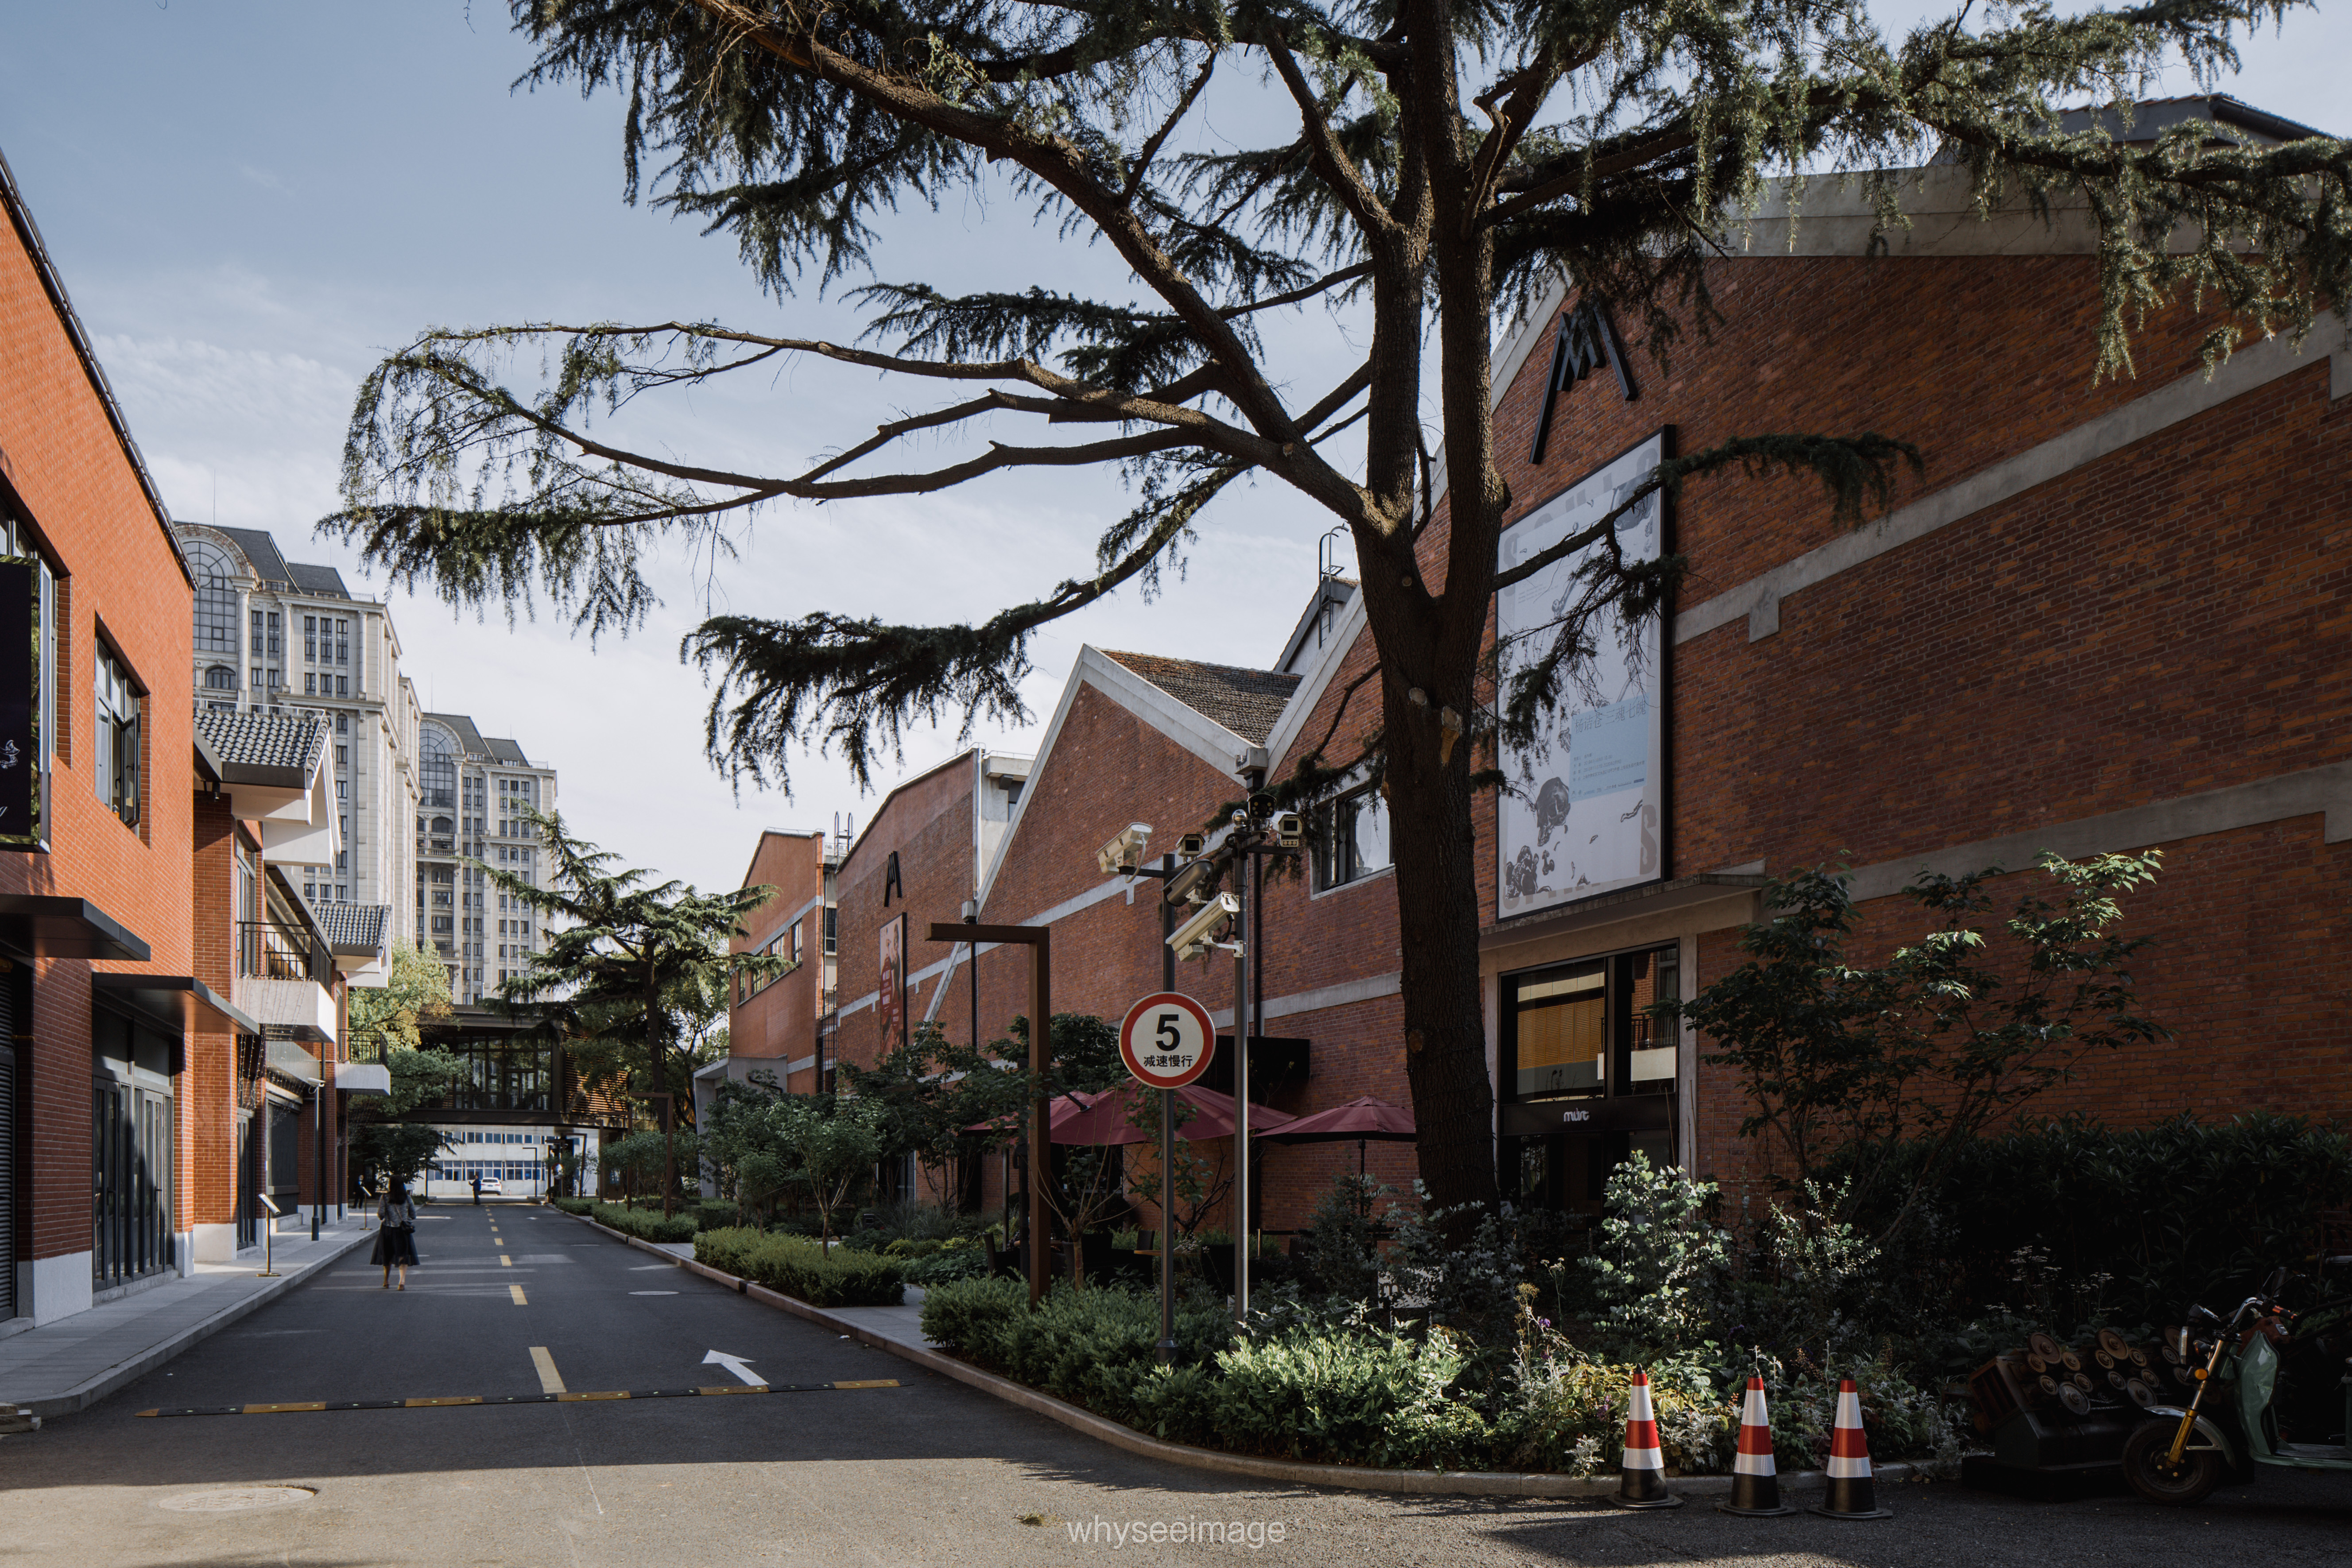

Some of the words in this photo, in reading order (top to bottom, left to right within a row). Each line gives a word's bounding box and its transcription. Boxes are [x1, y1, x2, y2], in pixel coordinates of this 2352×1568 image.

[1574, 713, 1602, 734] 杨诘苍
[1605, 700, 1646, 724] 三魂七魄
[1155, 1014, 1181, 1051] 5
[1143, 1055, 1193, 1067] 减速慢行
[1381, 1281, 1437, 1296] mt
